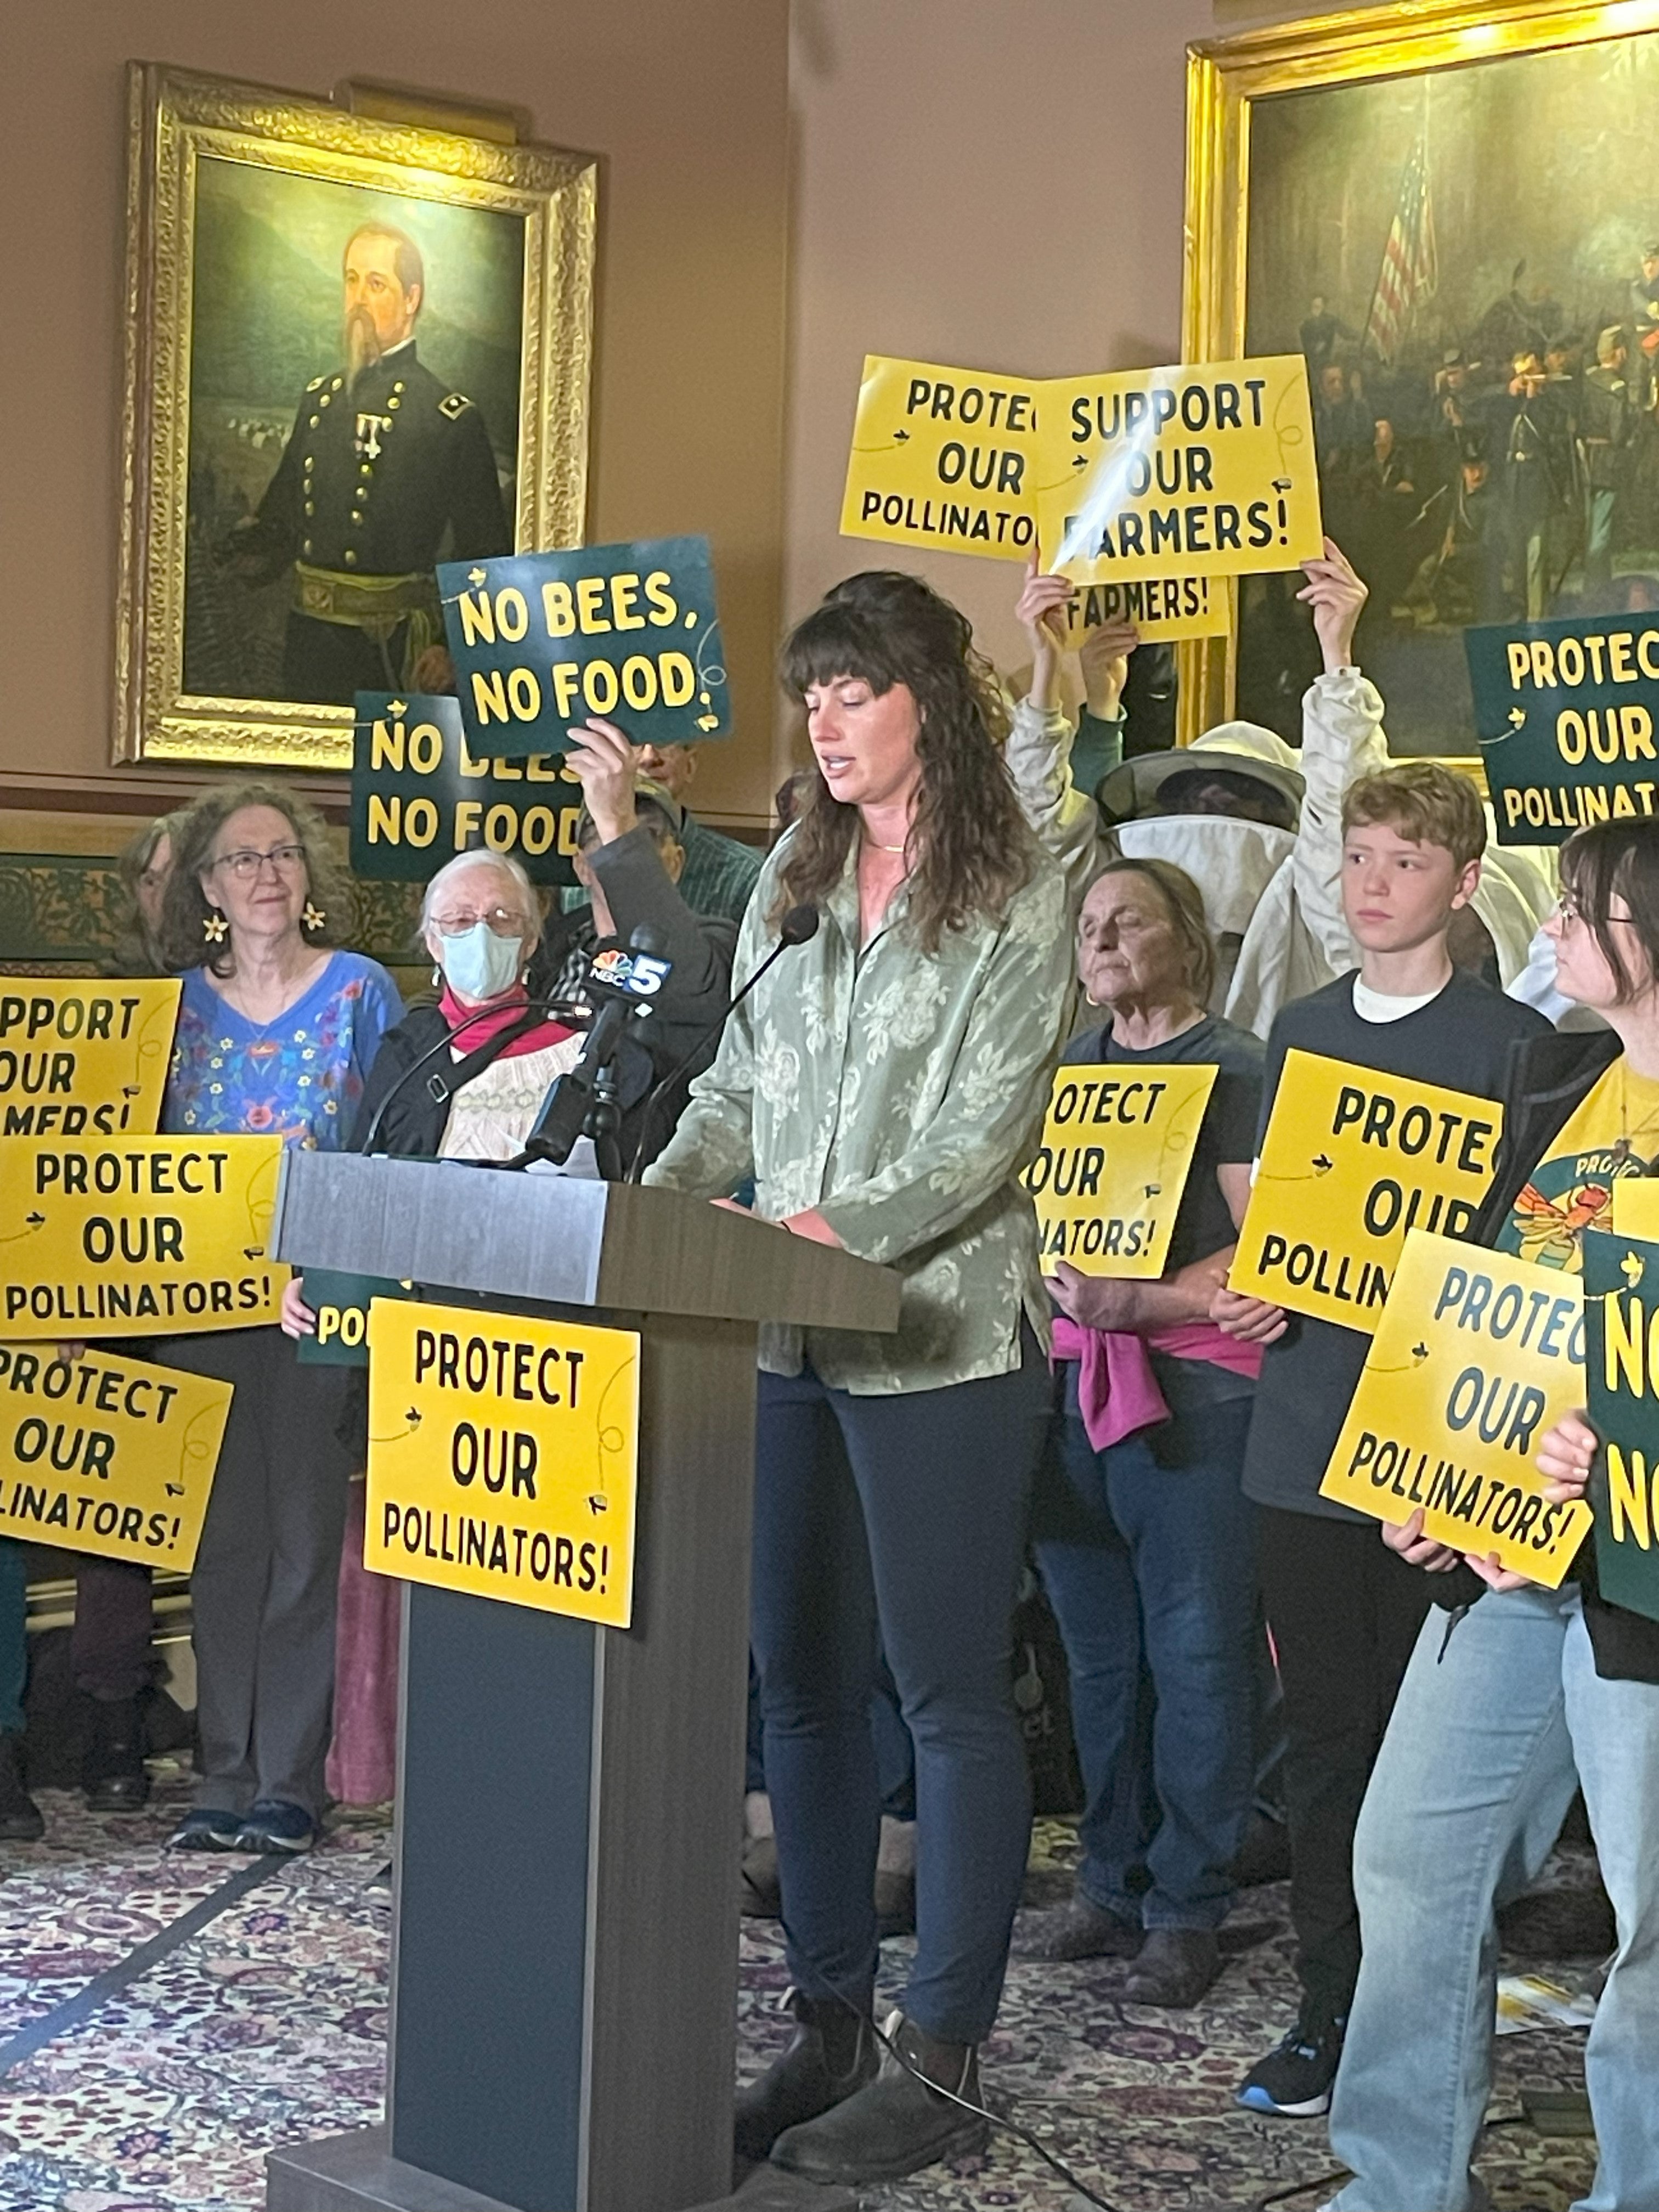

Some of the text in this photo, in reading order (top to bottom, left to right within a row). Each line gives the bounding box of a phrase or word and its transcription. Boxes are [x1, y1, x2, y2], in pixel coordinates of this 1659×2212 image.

[906, 379, 1036, 432] PROTE
[1071, 380, 1265, 443] SUPPORT
[938, 442, 1024, 495] OUR
[1125, 447, 1213, 497] OUR
[862, 491, 1038, 548] POLLINATO
[459, 571, 697, 646] NO BEES,
[1507, 630, 1659, 690] PROTEC
[471, 652, 711, 724] NO FOOD.
[370, 720, 442, 774] NO
[1556, 706, 1657, 765] OUR
[368, 794, 438, 847] NO
[1503, 783, 1655, 827] POLLINAT
[628, 955, 668, 995] 5
[0, 997, 140, 1040] PPORT
[0, 1051, 75, 1093] OUR
[1333, 1087, 1498, 1175] PROTE
[36, 1153, 228, 1194] PROTECT
[1026, 1148, 1105, 1196] OUR
[82, 1216, 184, 1263] OUR
[6, 1276, 271, 1319] POLLINATORS!
[318, 1306, 368, 1347] PO
[415, 1329, 584, 1408] PROTECT
[1446, 1367, 1545, 1455] OUR
[14, 1418, 115, 1479] OUR
[452, 1422, 538, 1499] OUR
[1348, 1431, 1575, 1554] POLLINATORS!
[1607, 1443, 1659, 1551] N
[383, 1502, 607, 1594] POLLINATORS!
